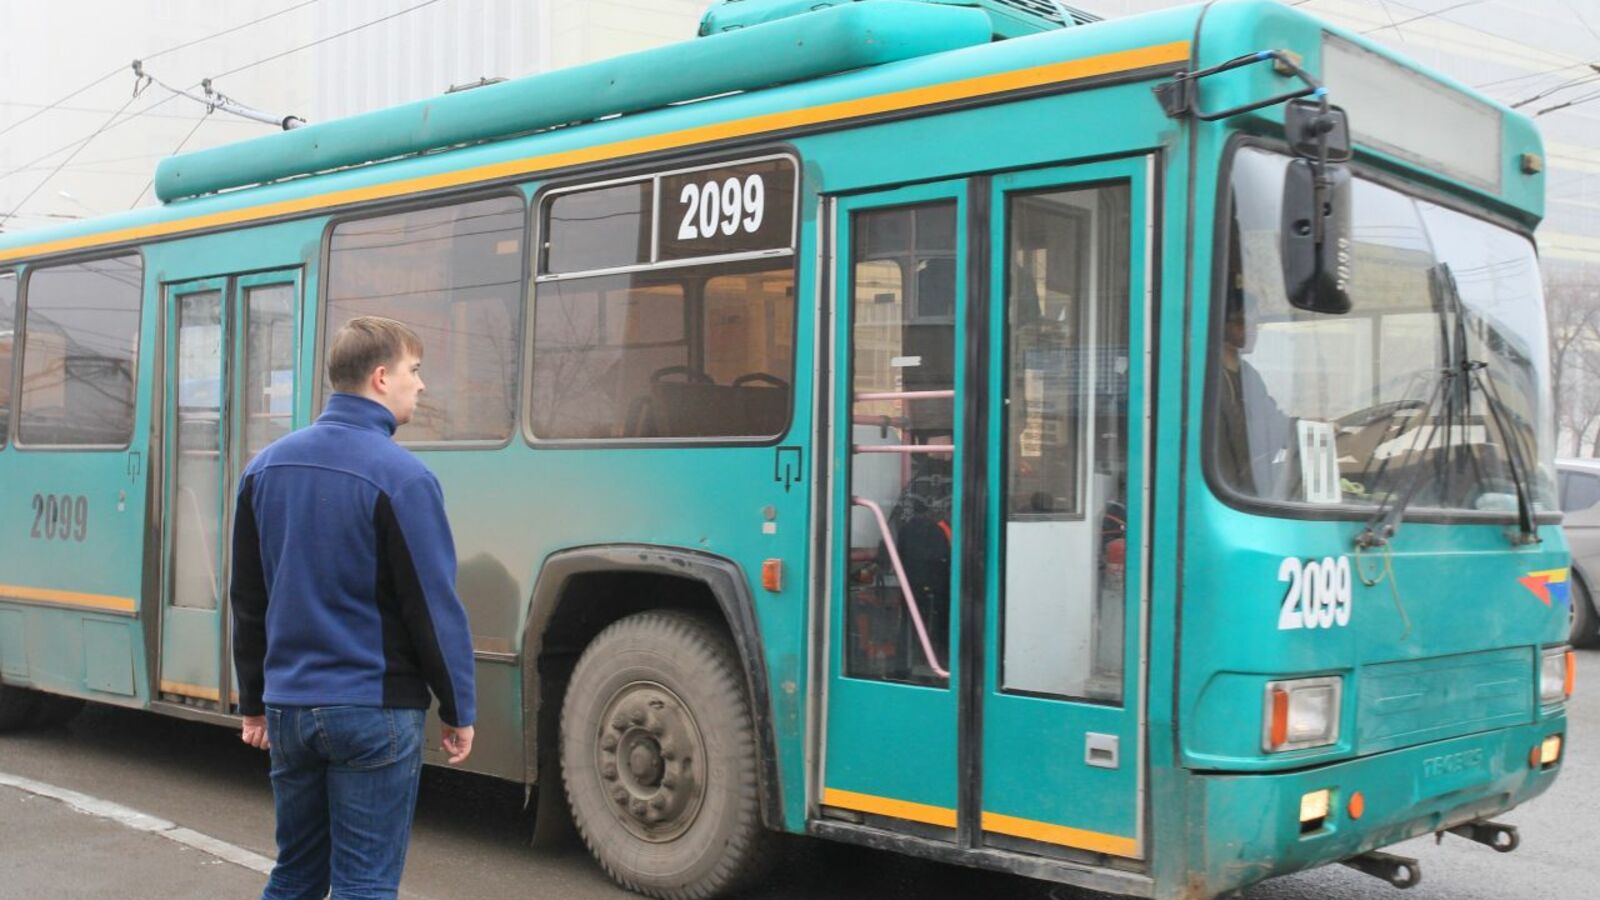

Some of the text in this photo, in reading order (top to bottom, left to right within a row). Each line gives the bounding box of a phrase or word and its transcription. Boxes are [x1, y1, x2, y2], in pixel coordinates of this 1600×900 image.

[677, 173, 765, 240] 2099
[30, 493, 88, 543] 2099
[1278, 555, 1352, 630] 2099
